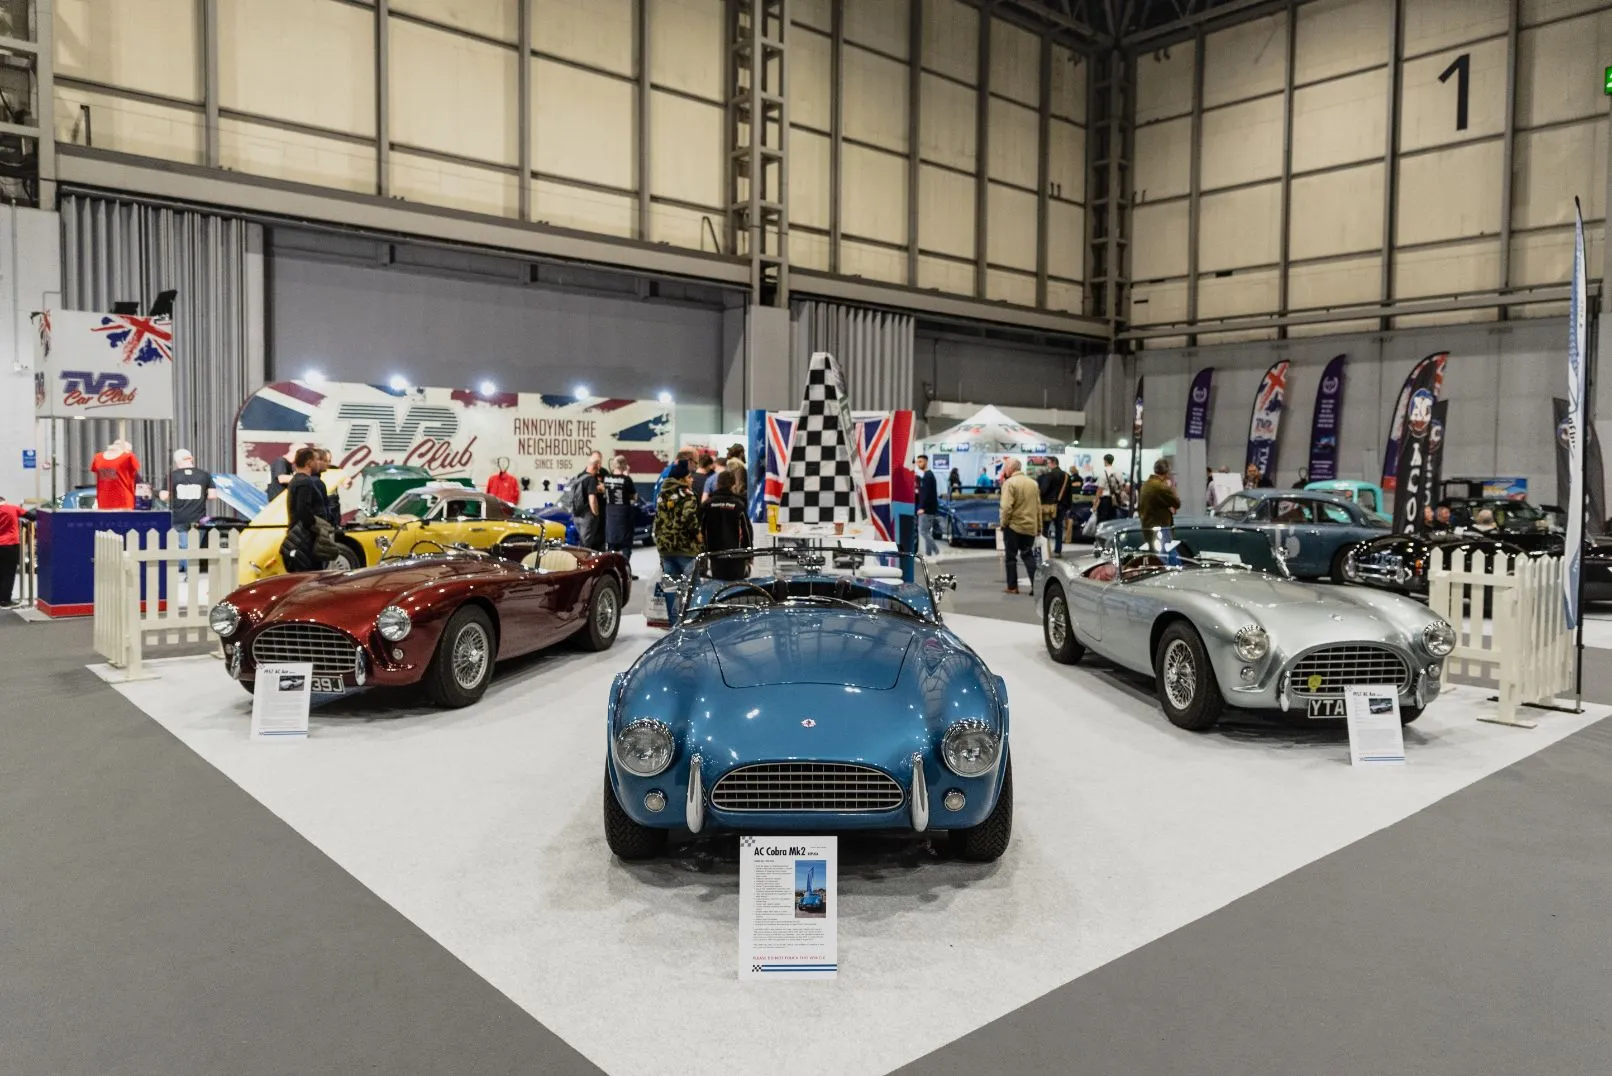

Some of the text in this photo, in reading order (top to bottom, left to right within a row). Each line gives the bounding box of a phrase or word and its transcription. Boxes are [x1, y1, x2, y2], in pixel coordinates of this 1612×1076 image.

[1438, 53, 1470, 131] 1
[60, 370, 129, 394] TVR
[64, 389, 93, 406] Car
[98, 387, 138, 405] Club
[336, 403, 459, 453] TVR
[513, 417, 597, 438] ANNOYING THE
[403, 436, 478, 471] Club
[518, 437, 593, 457] NEIGHBOURS
[535, 459, 573, 470] SINCE 1965
[1312, 699, 1345, 716] YTA
[754, 847, 765, 856] AC
[766, 846, 787, 856] Cobra
[789, 846, 806, 856] Mk2
